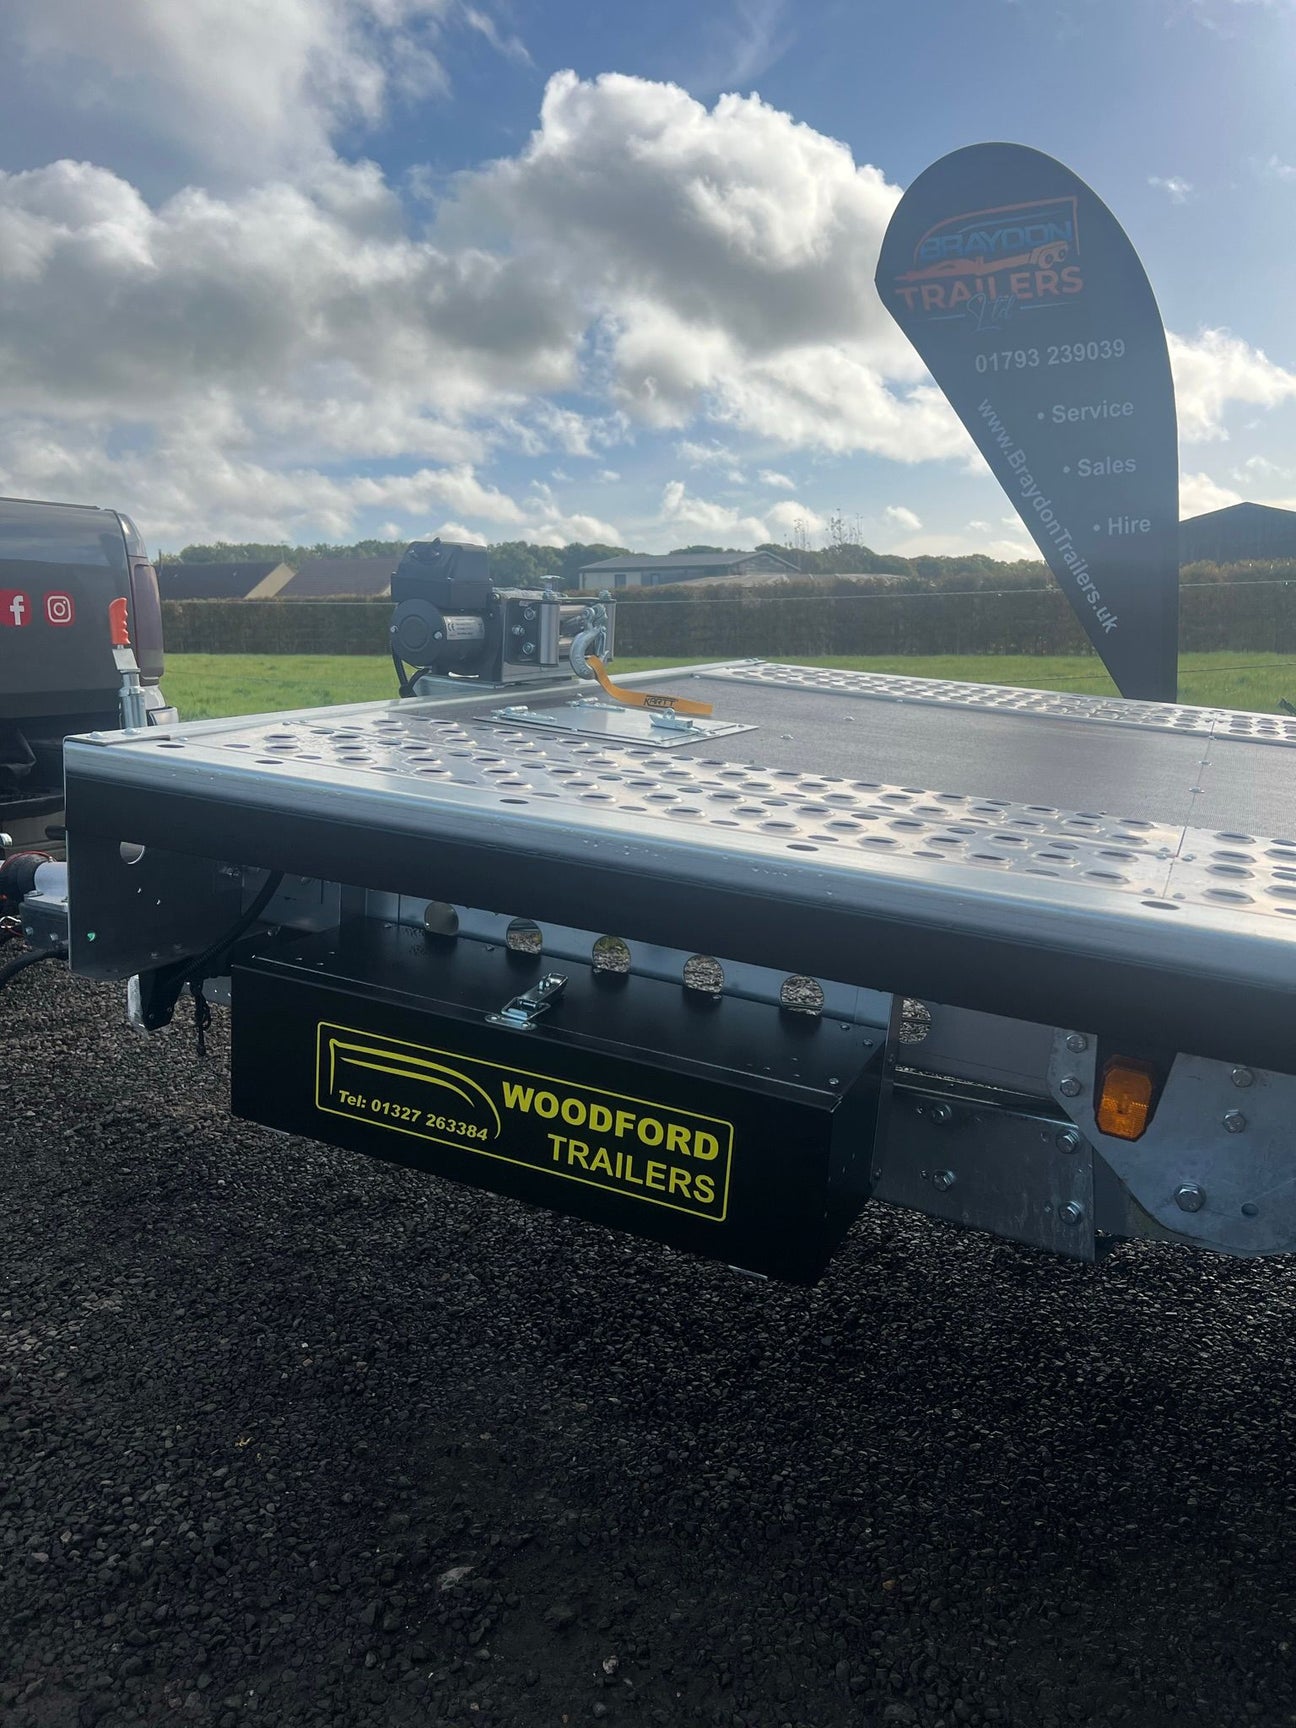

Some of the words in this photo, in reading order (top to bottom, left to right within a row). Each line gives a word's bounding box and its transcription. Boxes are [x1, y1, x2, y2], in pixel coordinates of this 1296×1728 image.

[920, 221, 1073, 261] BRAYDON
[896, 266, 1084, 312] TRAILERS
[975, 348, 1040, 374] 01793
[1047, 338, 1126, 366] 239039
[1052, 400, 1135, 424] Service
[1077, 456, 1137, 478] Sales
[977, 398, 1118, 634] www.BraydonTrailers.uk
[1108, 515, 1152, 536] Hire
[338, 1090, 367, 1110] Tel:
[371, 1098, 421, 1124] 01327
[425, 1112, 488, 1141] 263384
[502, 1081, 719, 1161] WOODFORD
[548, 1133, 715, 1204] TRAILERS
